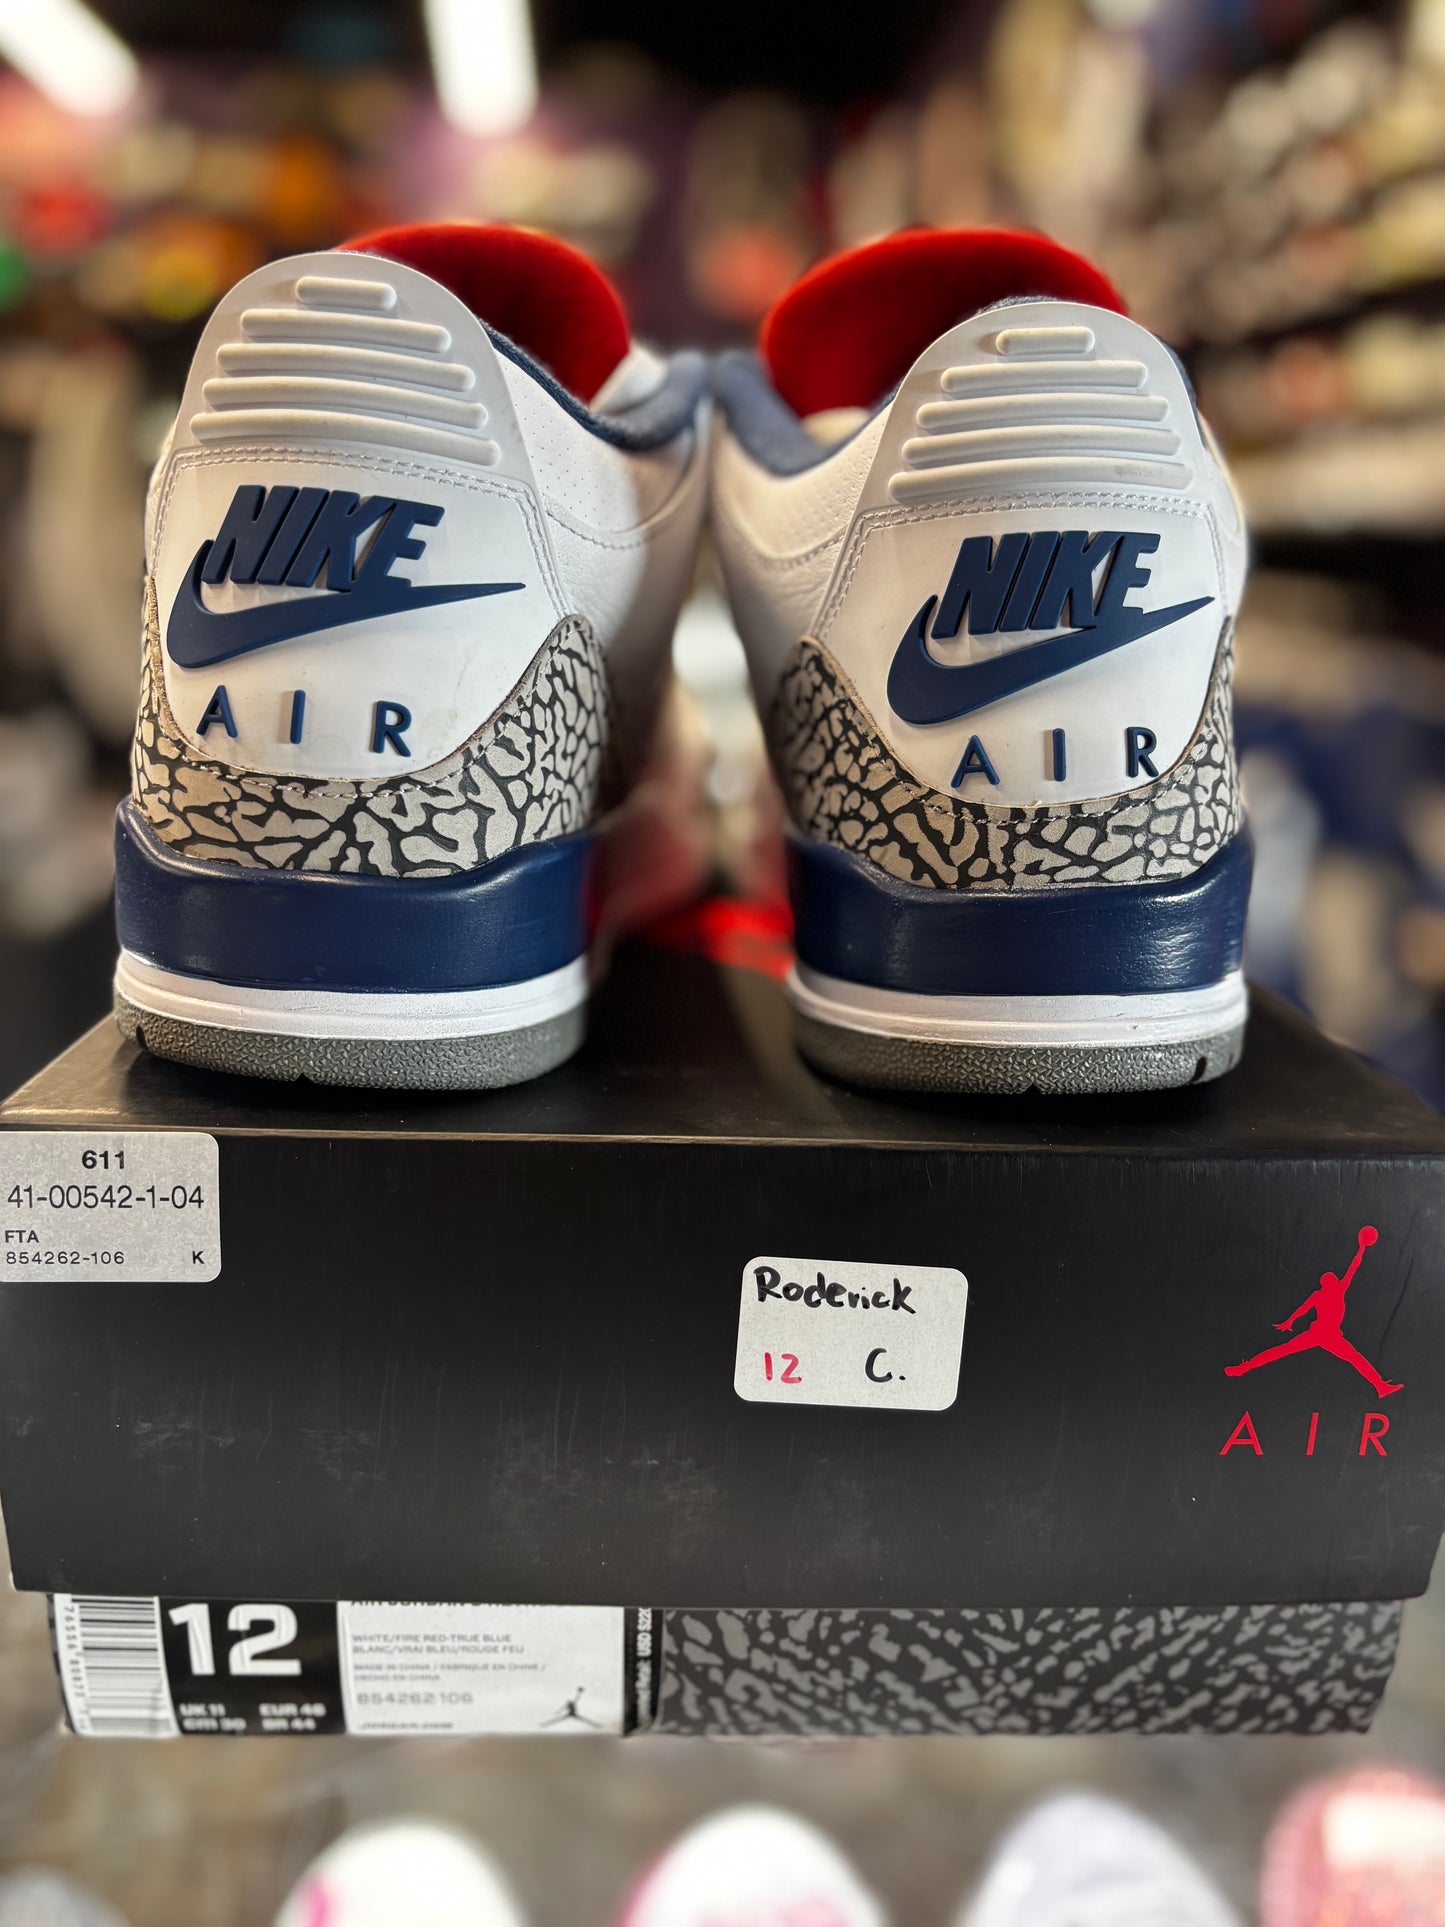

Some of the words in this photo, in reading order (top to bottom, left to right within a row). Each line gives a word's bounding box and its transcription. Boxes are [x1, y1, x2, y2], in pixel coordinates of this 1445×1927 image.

[201, 485, 445, 592] NIKE
[931, 531, 1161, 639] NIKE
[196, 685, 411, 757] AIR
[951, 727, 1160, 788] AIR
[81, 1149, 125, 1169] 611
[7, 1184, 205, 1209] 41-00542-1-04
[4, 1230, 40, 1243] FTA
[6, 1251, 125, 1265] 854262-106
[192, 1250, 205, 1264] K
[753, 1265, 917, 1314] Roderick
[764, 1352, 802, 1384] 12
[1219, 1410, 1391, 1456] AIR
[168, 1602, 302, 1676] 12
[482, 1633, 512, 1643] BLUE
